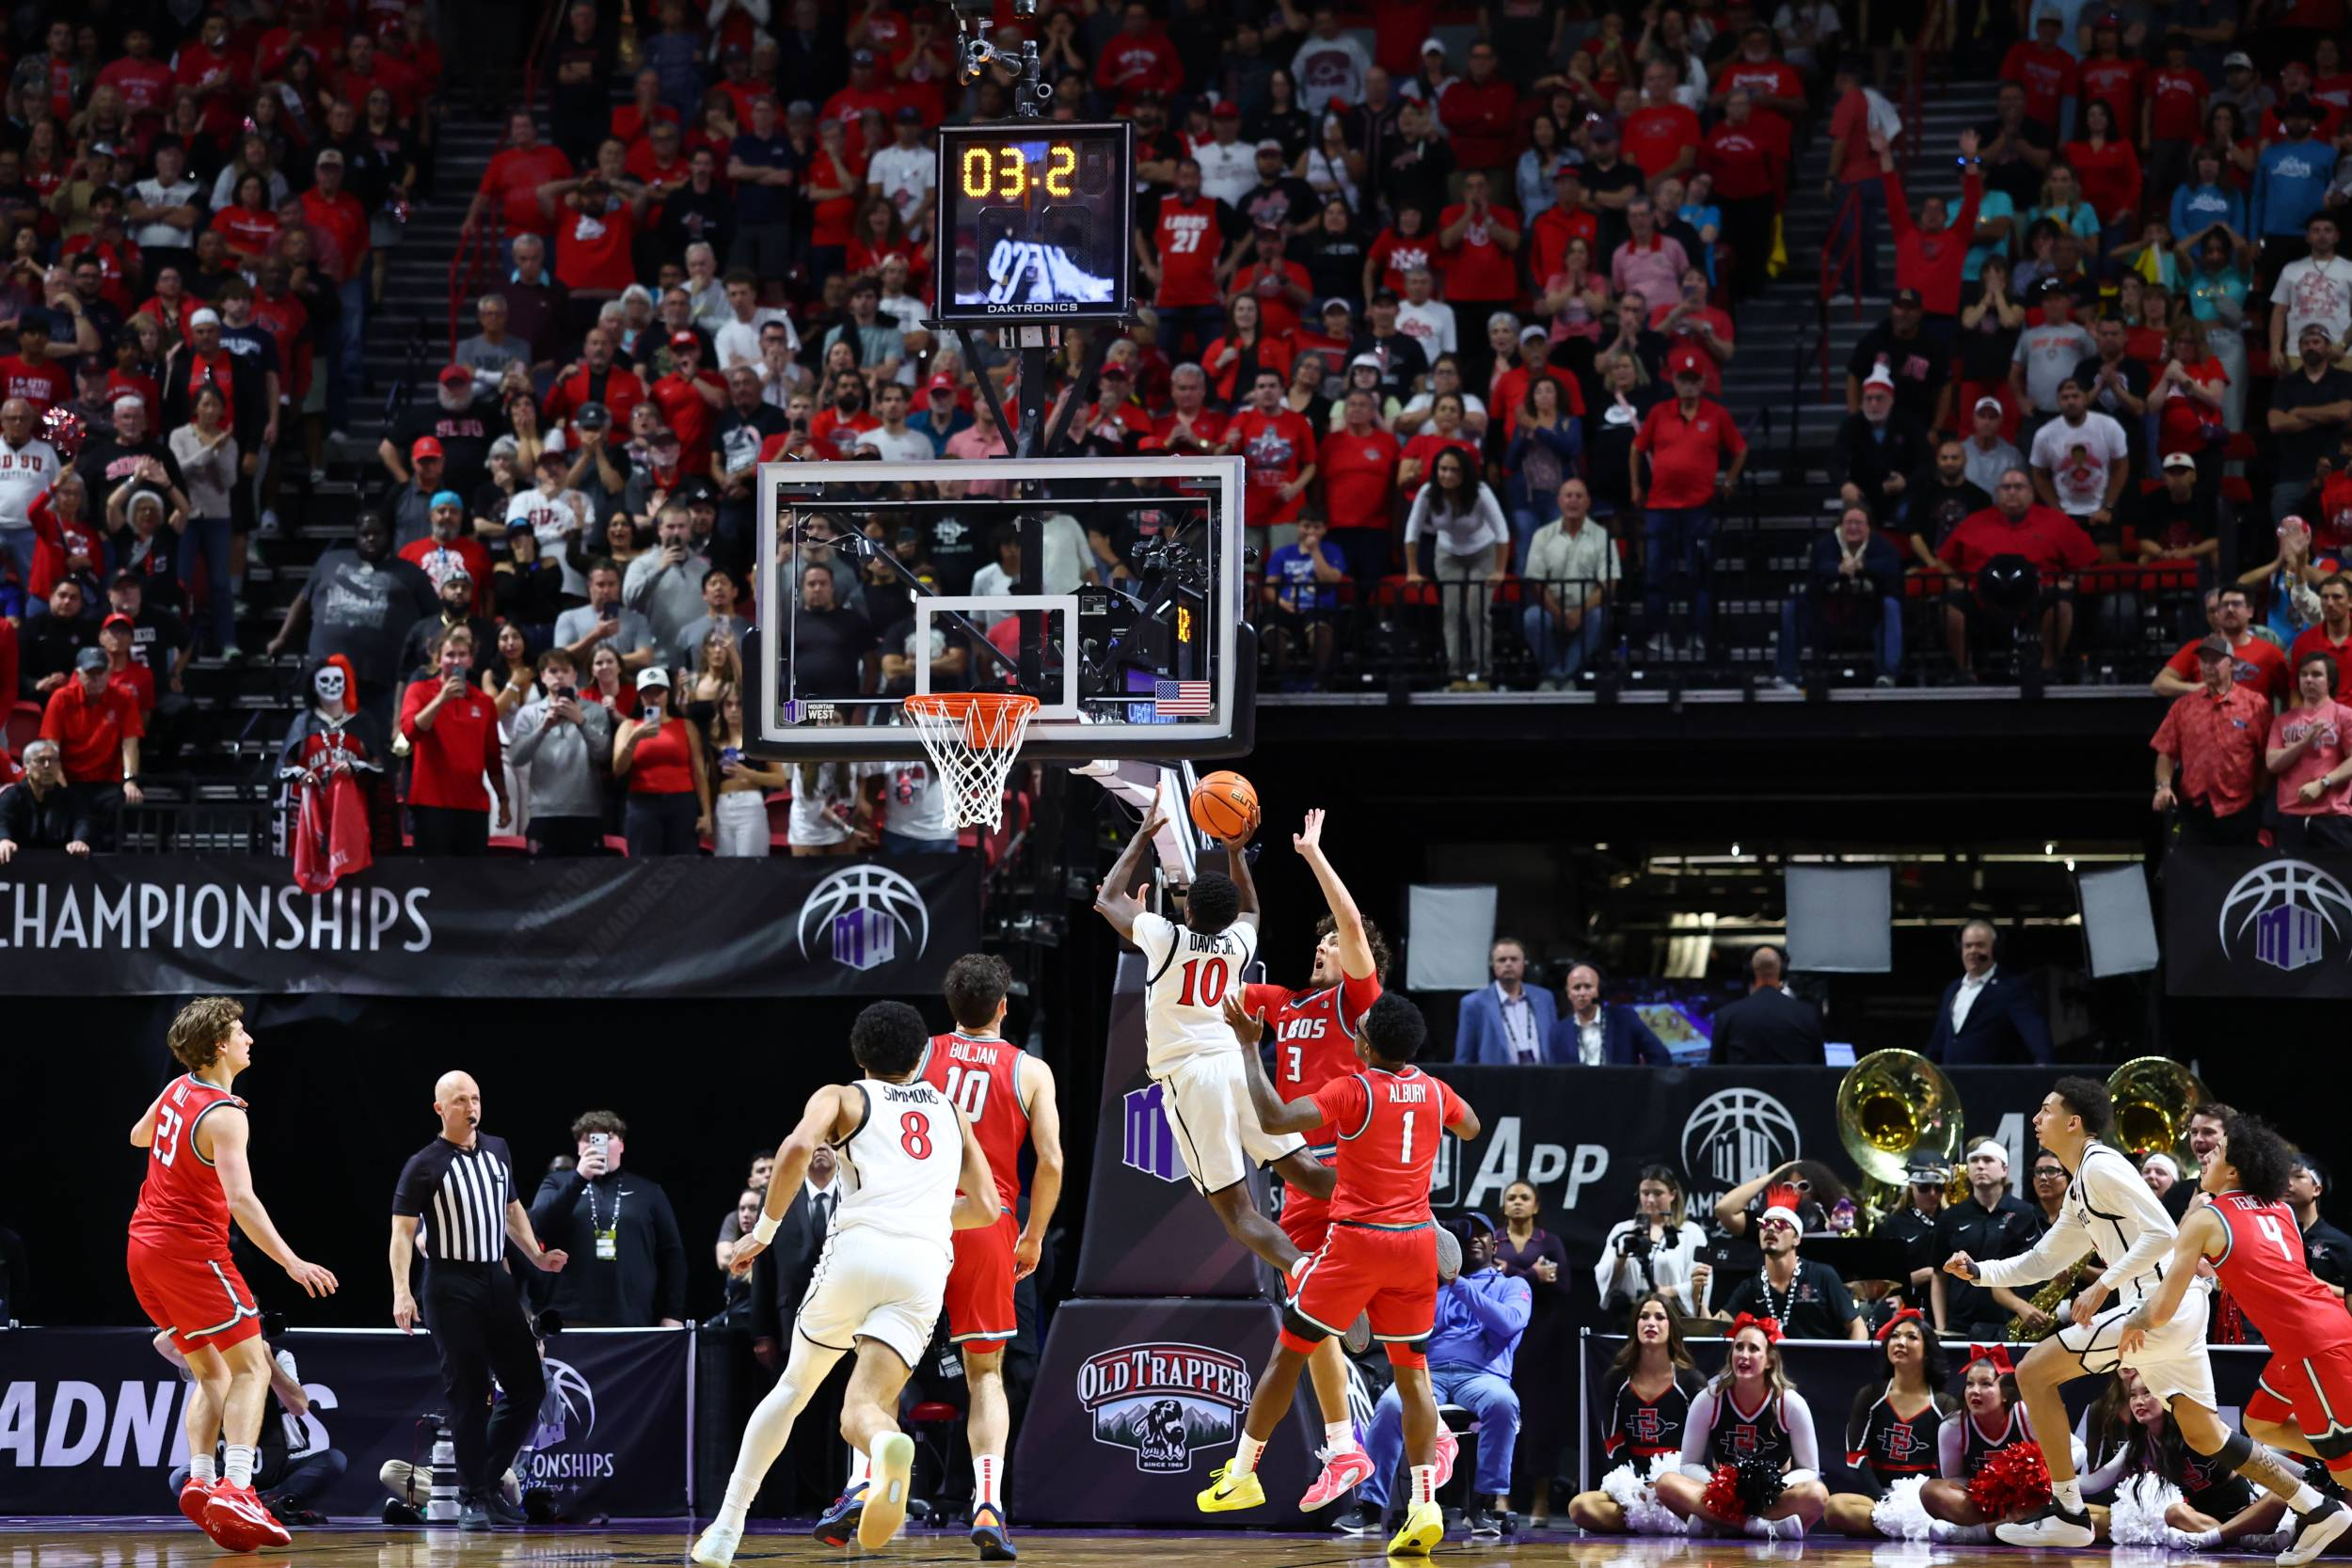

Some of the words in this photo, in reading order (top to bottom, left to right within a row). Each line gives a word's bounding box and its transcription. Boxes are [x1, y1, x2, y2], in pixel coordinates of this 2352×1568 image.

[963, 147, 1074, 198] 03.2
[1170, 230, 1201, 253] 21
[987, 303, 1078, 313] DAKTRONICS
[808, 710, 834, 720] WEST
[0, 881, 432, 953] CHAMPIONSHIPS
[1189, 933, 1220, 953] DAVIS
[1177, 957, 1229, 1007] 10
[949, 1042, 998, 1066] BULJAN
[1287, 1046, 1301, 1083] 3
[883, 1085, 939, 1104] SIMMONS
[944, 1066, 992, 1122] 10
[1389, 1084, 1426, 1103] ALBURY
[152, 1103, 184, 1167] 23
[900, 1111, 932, 1160] 8
[1401, 1110, 1416, 1164] 1
[2255, 1215, 2293, 1261] 4
[1080, 1363, 1131, 1401] OLD
[1131, 1350, 1250, 1405] TRAPPER
